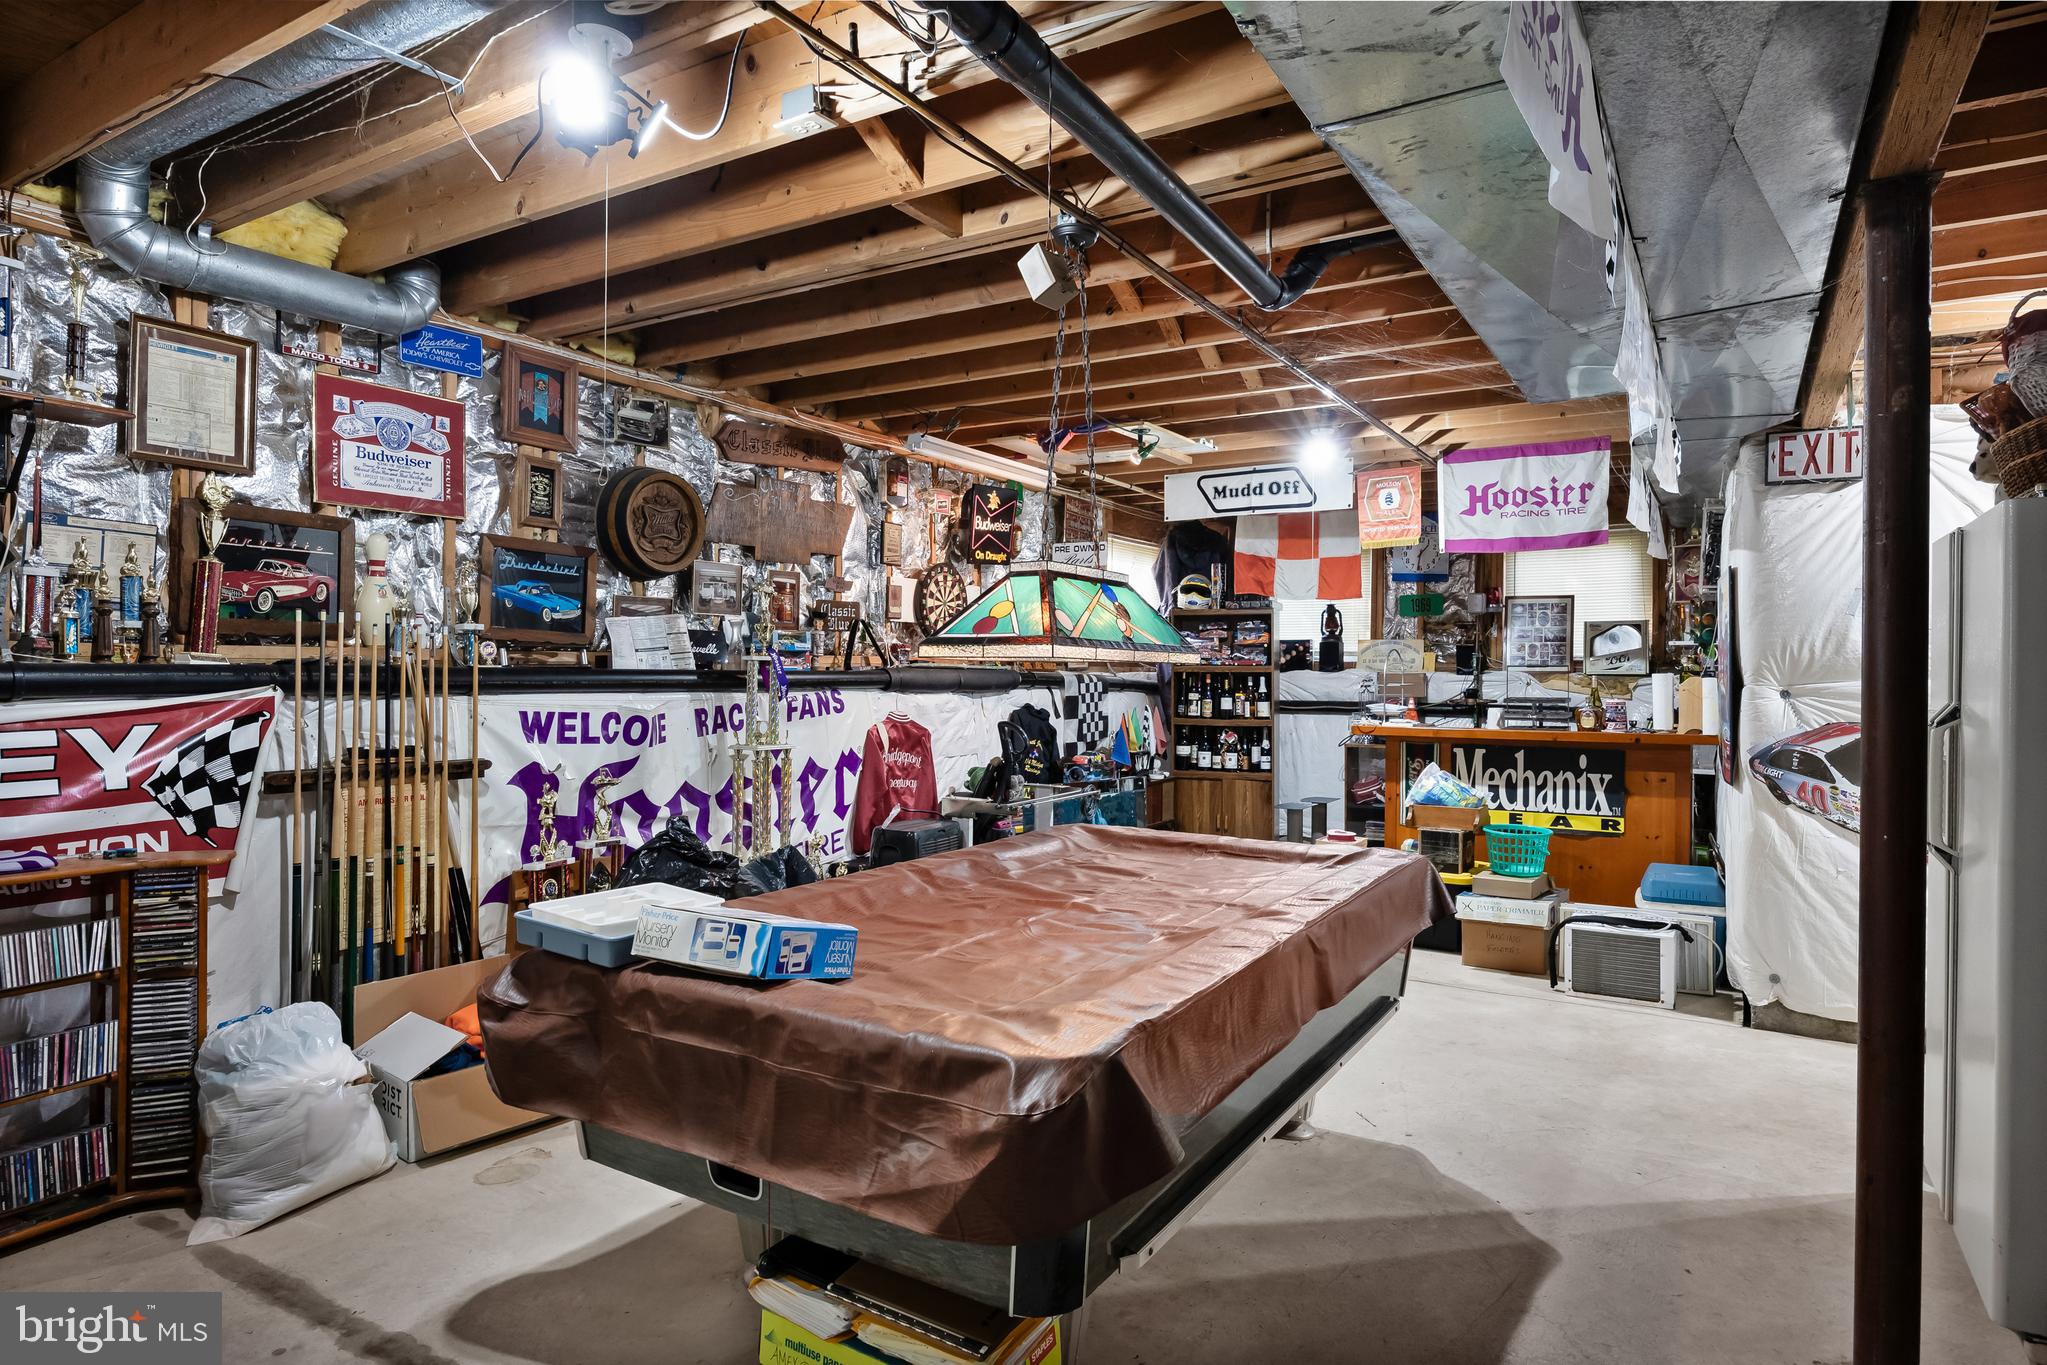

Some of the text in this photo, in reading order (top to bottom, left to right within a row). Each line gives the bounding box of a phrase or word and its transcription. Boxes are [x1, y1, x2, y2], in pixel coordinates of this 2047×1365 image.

[415, 336, 471, 351] Heartbeat
[422, 330, 433, 339] THE
[291, 347, 360, 369] MATCO TOOLS
[402, 347, 463, 368] TODAY'S CHEVROLET
[421, 347, 460, 359] OF AMERICA
[727, 429, 798, 458] Classic
[355, 445, 432, 470] Budweiser
[1778, 430, 1859, 478] EXIT
[1212, 480, 1300, 500] Mudd Off
[1376, 481, 1402, 489] MOLSON
[1459, 476, 1595, 517] Hoosier
[1500, 506, 1587, 519] RACING TIRE
[975, 515, 1011, 533] Budweiser
[975, 550, 1007, 563] On Draught
[1054, 543, 1106, 554] PRE OWND
[499, 555, 580, 577] Thunderbird
[821, 602, 856, 618] Classic
[1411, 597, 1431, 613] 1969
[828, 617, 849, 630] Blue
[690, 639, 720, 655] evelle
[786, 689, 846, 723] FANS
[1453, 747, 1612, 816] Mechanix
[1764, 767, 1784, 778] LIGHT
[1796, 780, 1831, 816] 40
[1508, 812, 1623, 832] EAR
[662, 912, 679, 921] Price
[1477, 904, 1544, 916] PAPER TRIMMER
[639, 917, 677, 938] Nursery
[636, 930, 672, 950] Monitor
[829, 940, 854, 954] Monitor
[824, 953, 852, 966] Nursery
[784, 1338, 821, 1361] multiuse
[1031, 1333, 1053, 1362] STAPLES
